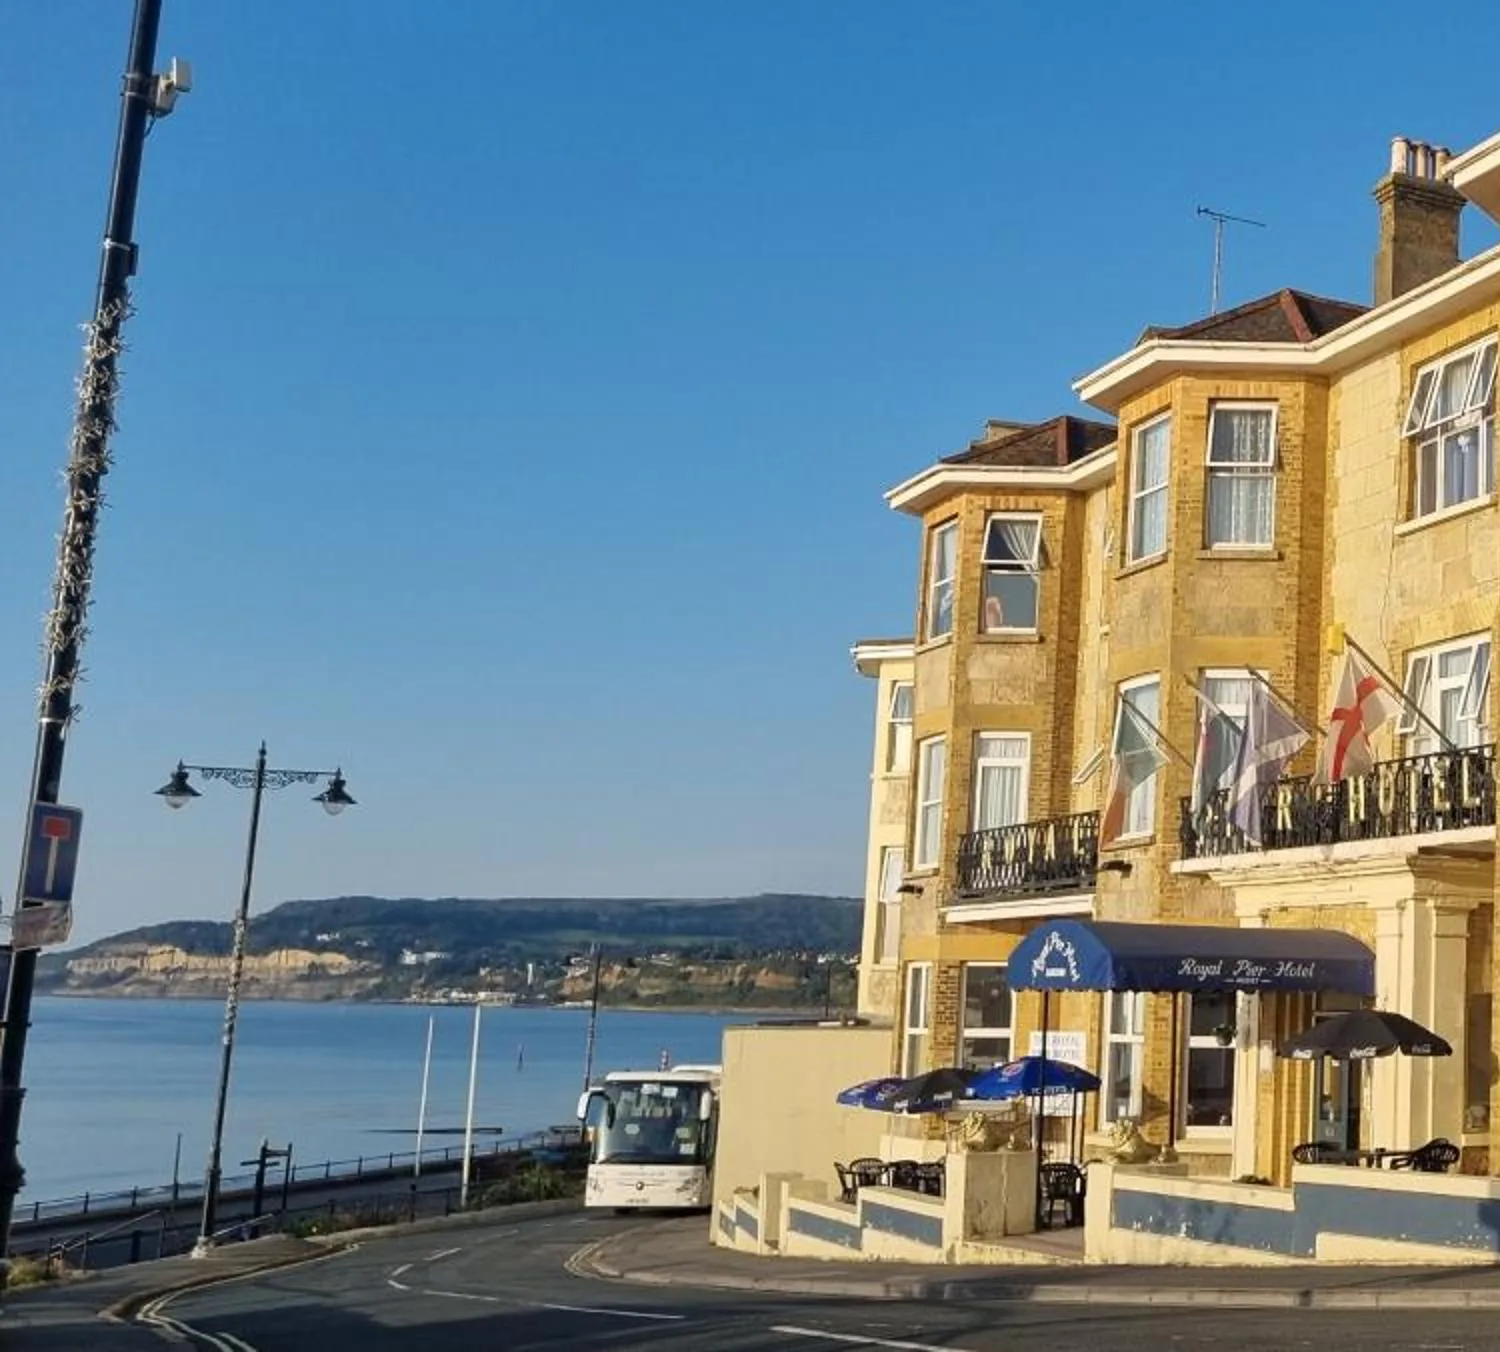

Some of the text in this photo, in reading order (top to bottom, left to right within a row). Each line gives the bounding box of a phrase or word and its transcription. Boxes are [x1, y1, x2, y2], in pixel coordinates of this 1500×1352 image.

[1178, 957, 1316, 981] Royal Pier Hotel
